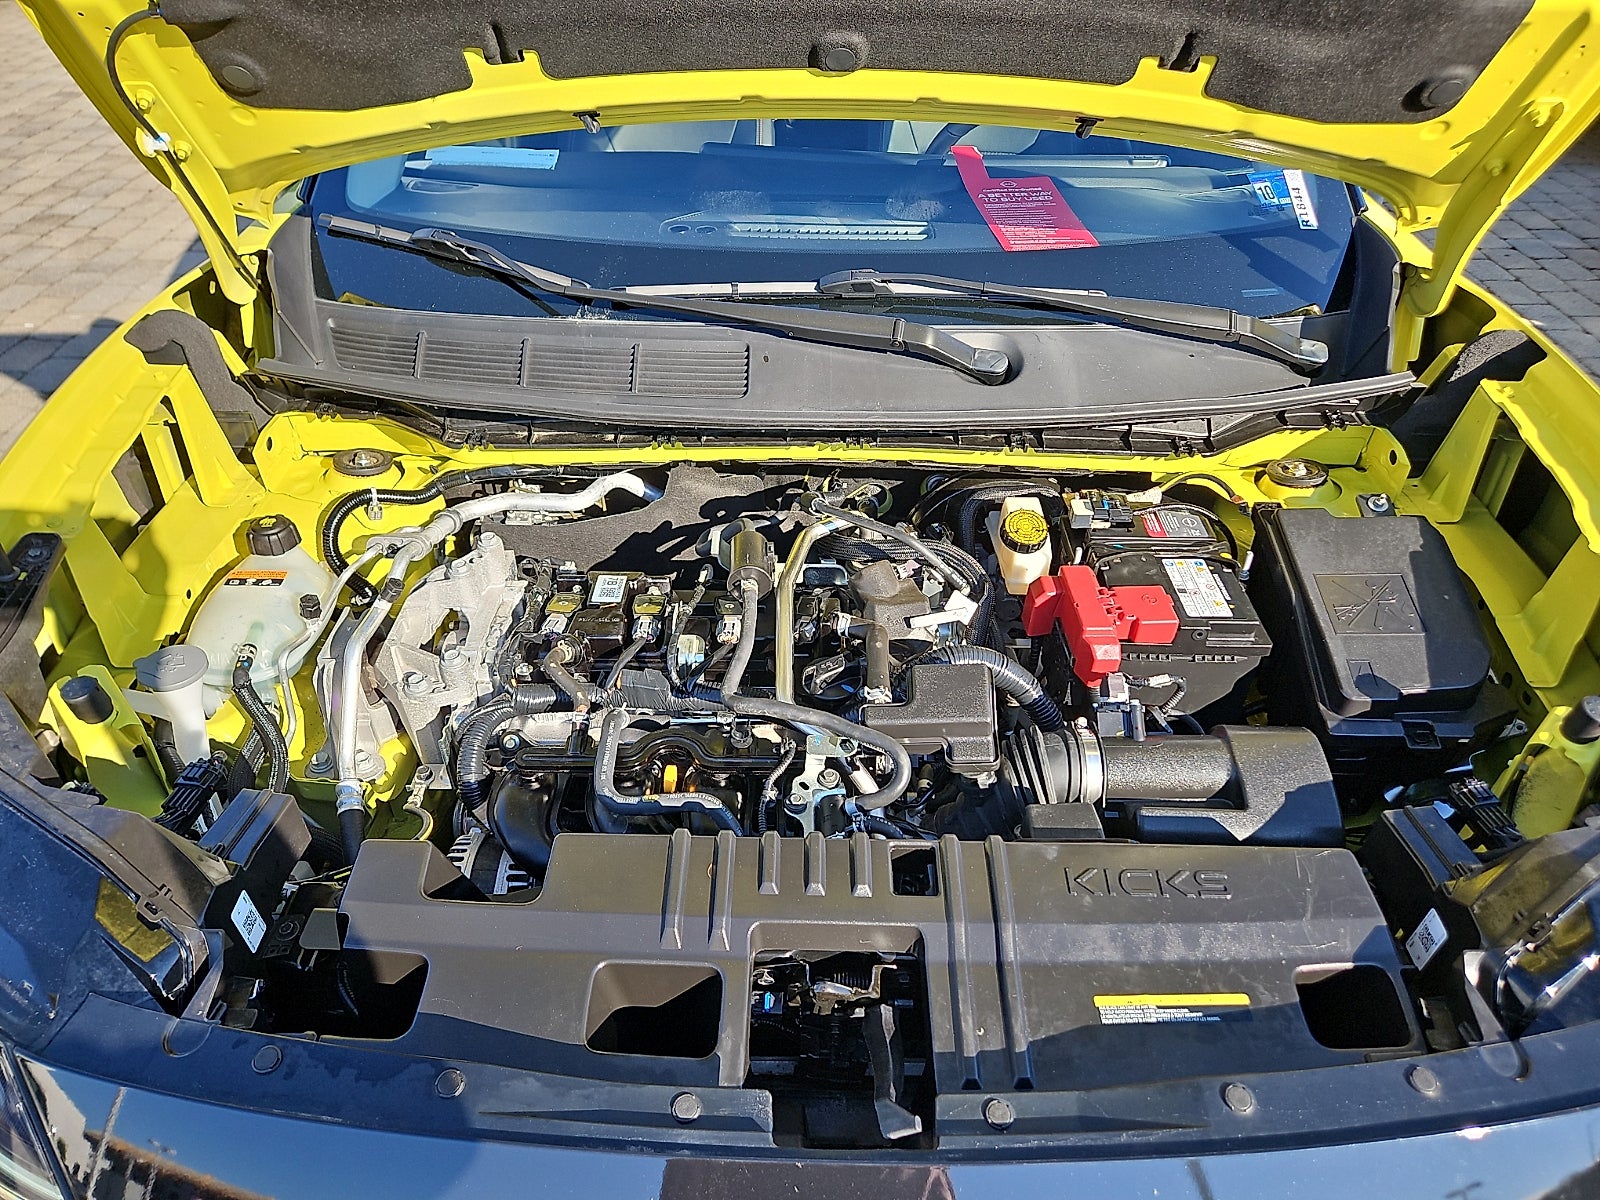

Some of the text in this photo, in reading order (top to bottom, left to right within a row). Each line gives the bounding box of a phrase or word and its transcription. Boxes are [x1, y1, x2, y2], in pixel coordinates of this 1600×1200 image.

[1257, 185, 1275, 200] 10
[1291, 186, 1312, 227] R1844
[1064, 867, 1232, 900] KICKS
